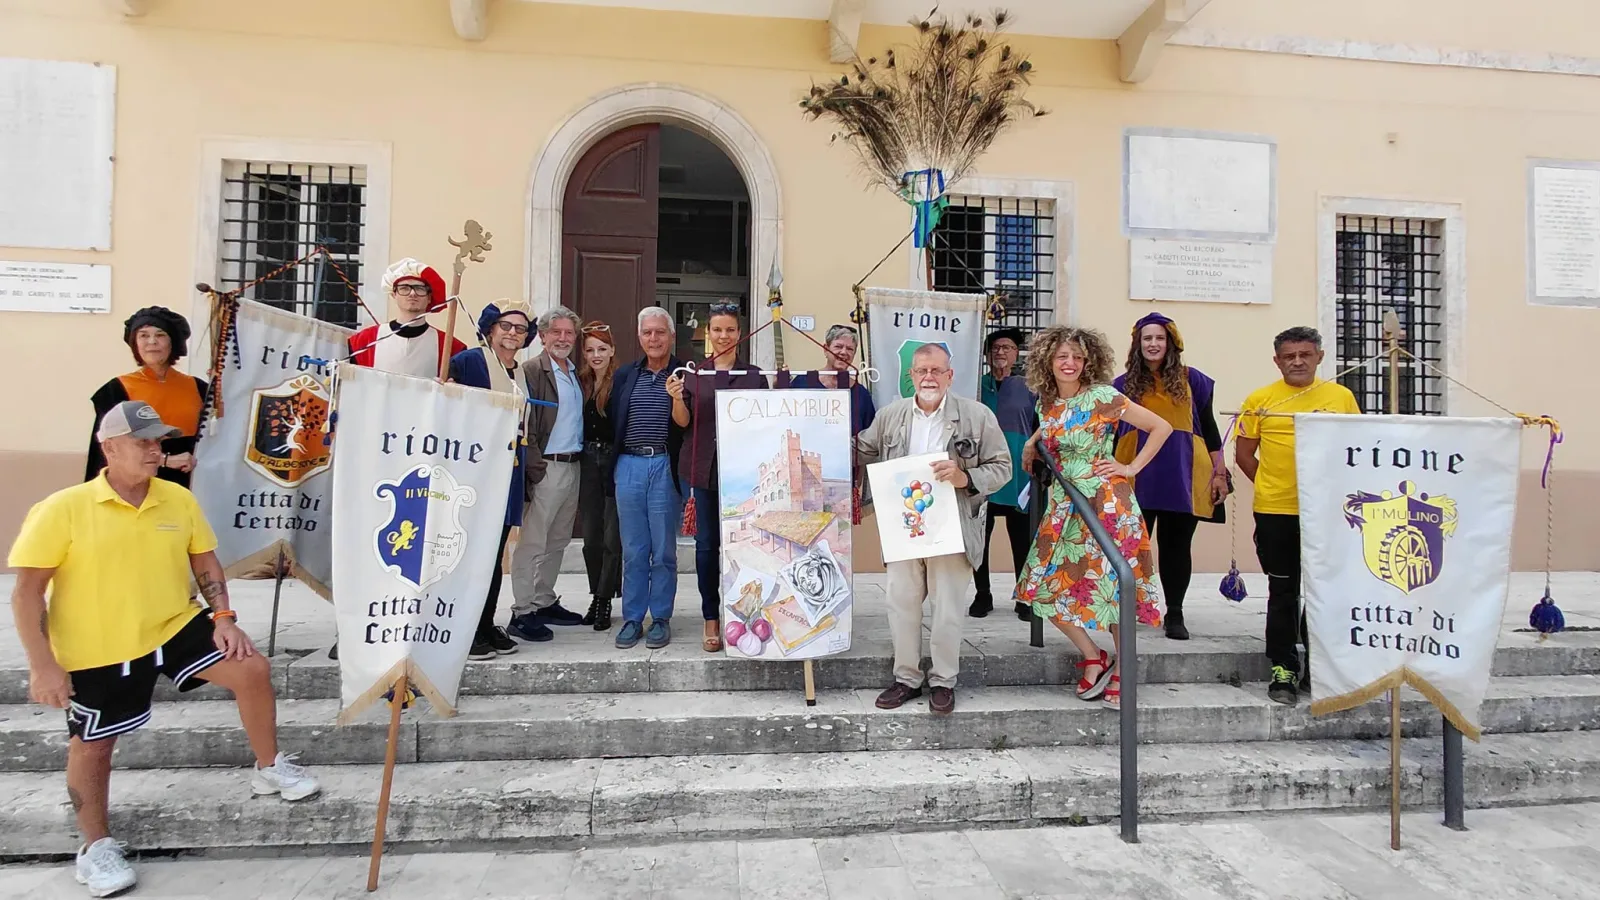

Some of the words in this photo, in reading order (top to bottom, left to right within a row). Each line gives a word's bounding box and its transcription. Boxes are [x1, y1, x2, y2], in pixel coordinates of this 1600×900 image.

[798, 319, 808, 329] 13
[893, 306, 962, 334] rione
[261, 345, 332, 378] rion
[727, 396, 845, 423] CALAMBUR
[381, 427, 484, 464] rione
[1345, 440, 1465, 475] rione
[300, 493, 323, 511] di
[417, 487, 451, 502] Vicario
[435, 597, 456, 619] di
[364, 621, 452, 645] Certaldo
[1432, 609, 1456, 634] di
[1350, 625, 1461, 660] Certaldo
